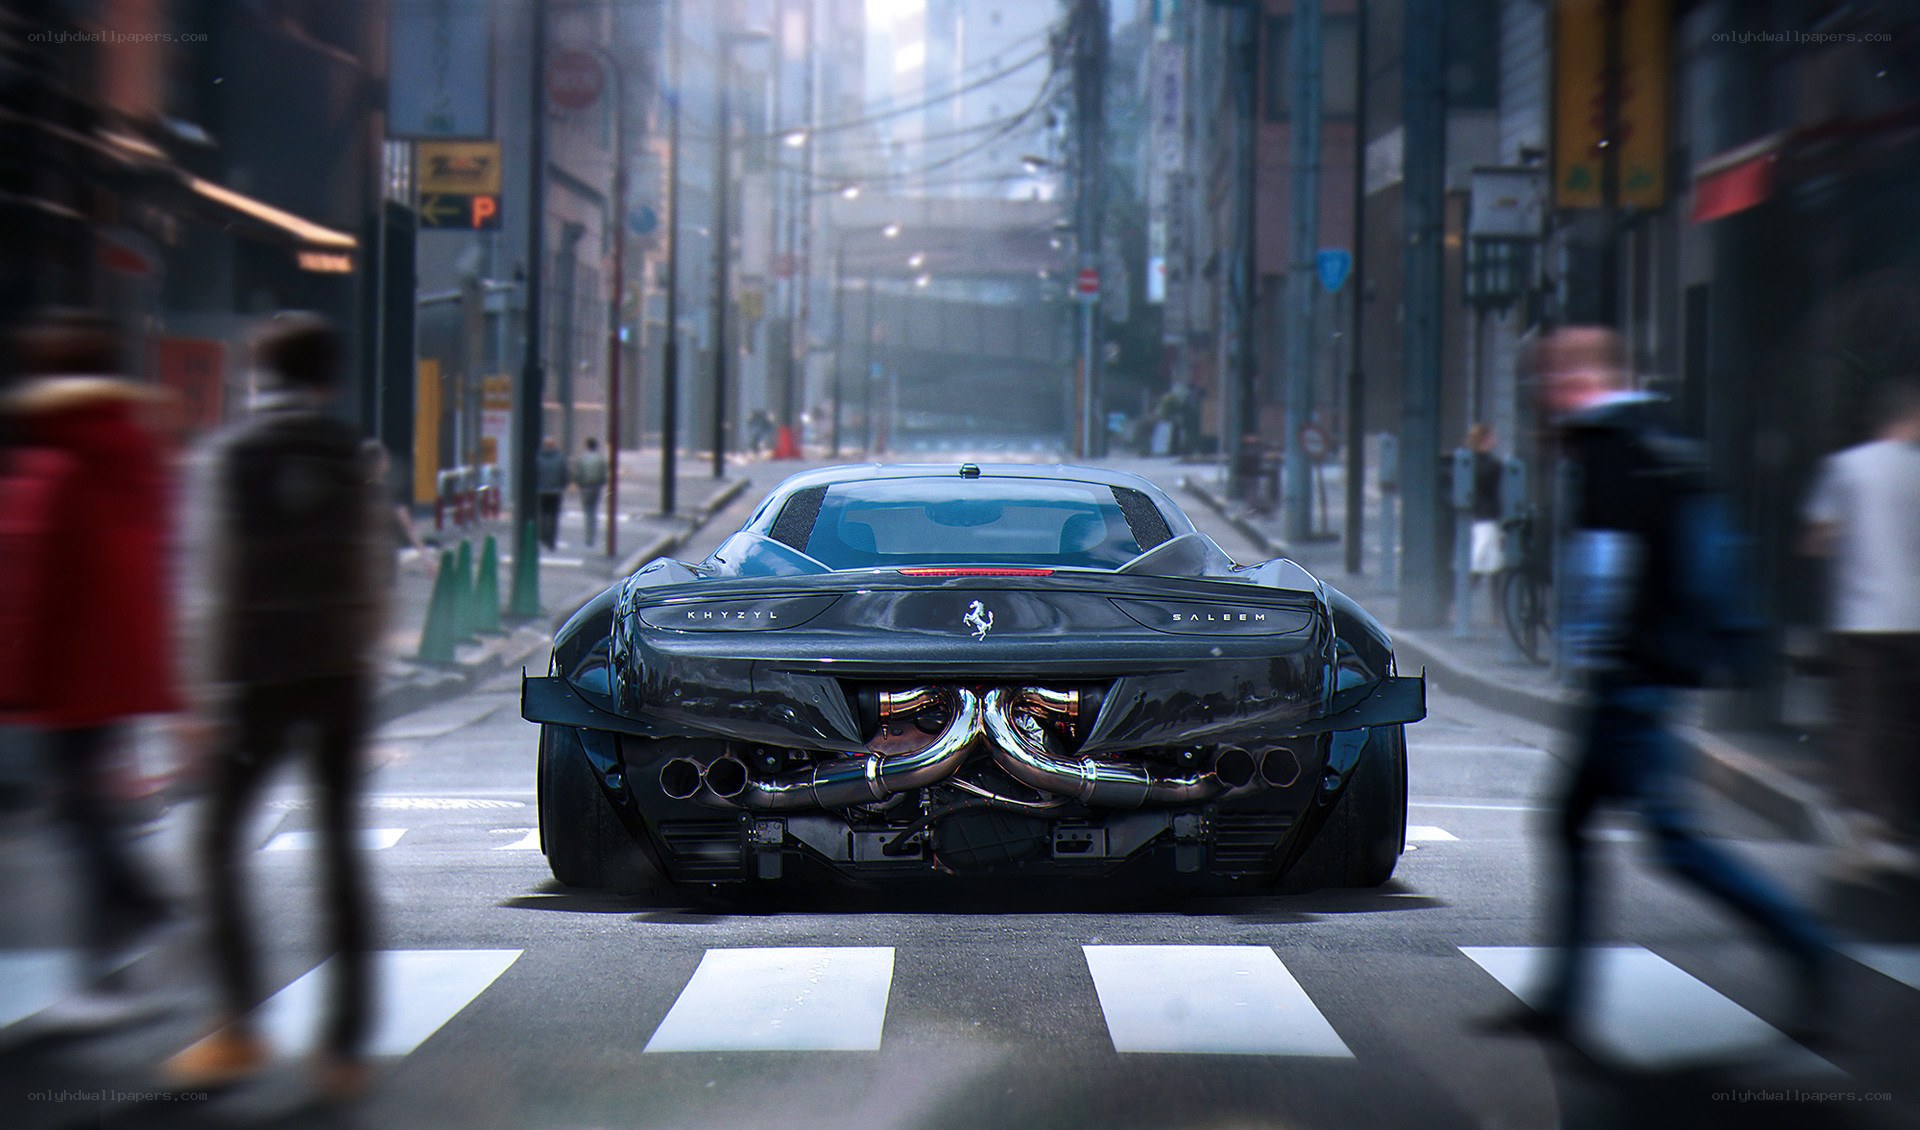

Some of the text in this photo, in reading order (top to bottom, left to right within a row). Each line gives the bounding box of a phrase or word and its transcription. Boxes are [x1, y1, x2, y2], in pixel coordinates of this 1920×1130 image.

[472, 194, 496, 229] P
[687, 611, 777, 619] KHYZYL
[1172, 613, 1266, 621] SALEEM
